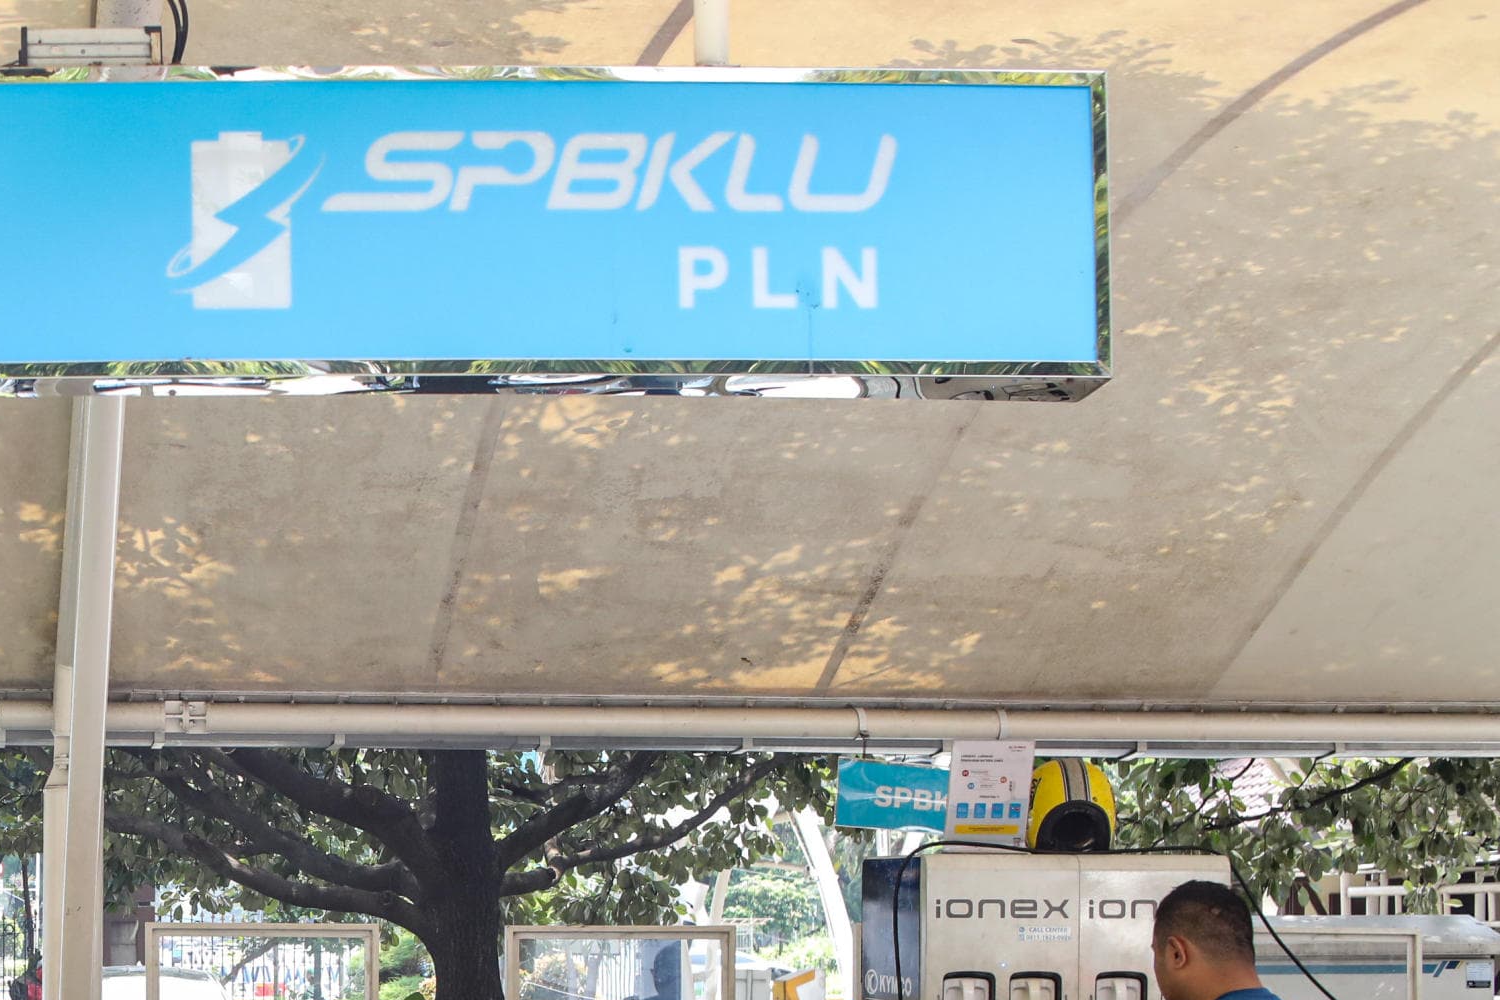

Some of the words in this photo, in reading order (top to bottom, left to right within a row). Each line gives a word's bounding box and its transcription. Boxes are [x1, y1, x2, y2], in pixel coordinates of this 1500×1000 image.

[320, 130, 897, 212] SPBKLU
[678, 245, 878, 308] PLN
[873, 785, 948, 812] SPBK
[936, 899, 1069, 918] ionex
[1088, 899, 1159, 919] ion
